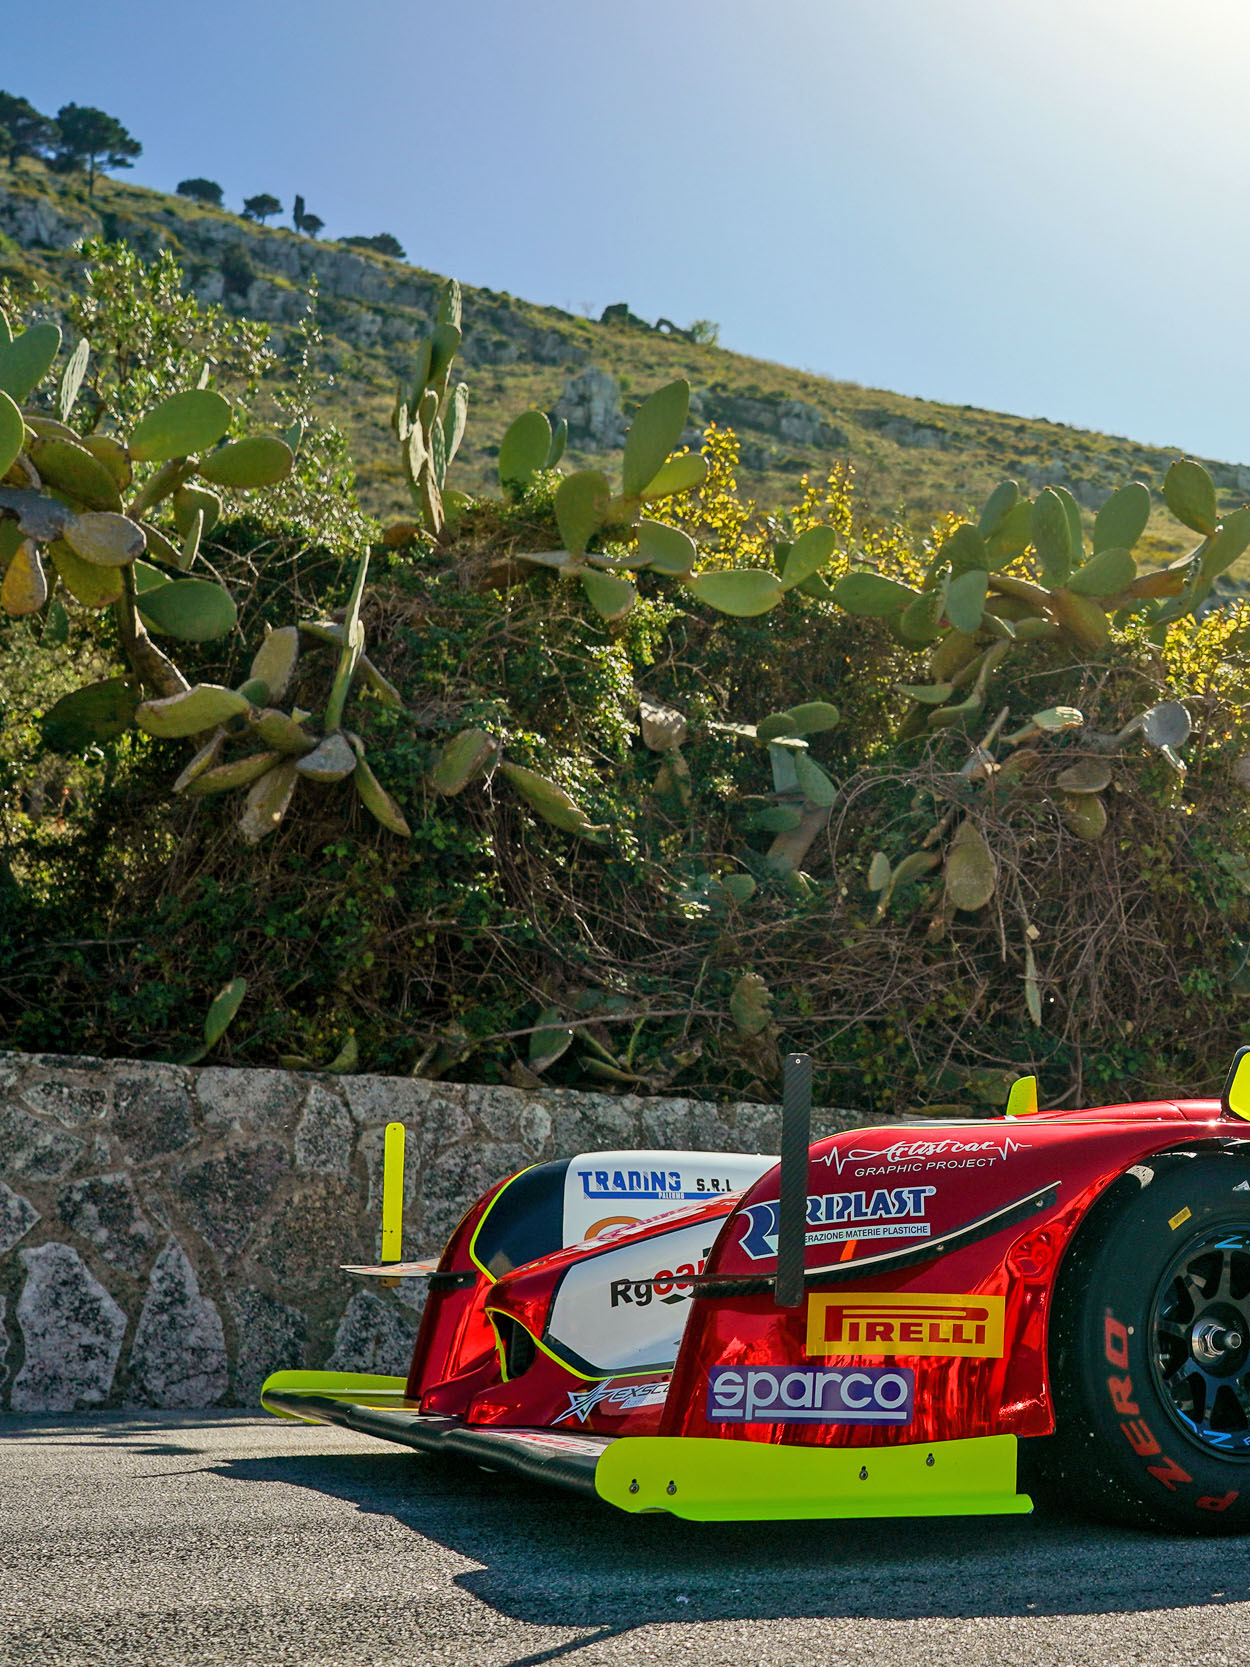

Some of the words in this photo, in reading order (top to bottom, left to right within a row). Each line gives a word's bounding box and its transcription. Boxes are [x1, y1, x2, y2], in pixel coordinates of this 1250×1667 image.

[854, 1163, 923, 1177] GRAPHIC
[926, 1157, 997, 1171] PROJECT
[804, 1232, 843, 1244] ERAZIONE
[845, 1229, 881, 1239] MATERIE
[882, 1225, 928, 1236] PLASTICHE
[824, 1305, 989, 1345] PIRELLI
[713, 1371, 909, 1420] sparco
[1104, 1315, 1193, 1491] ZERO
